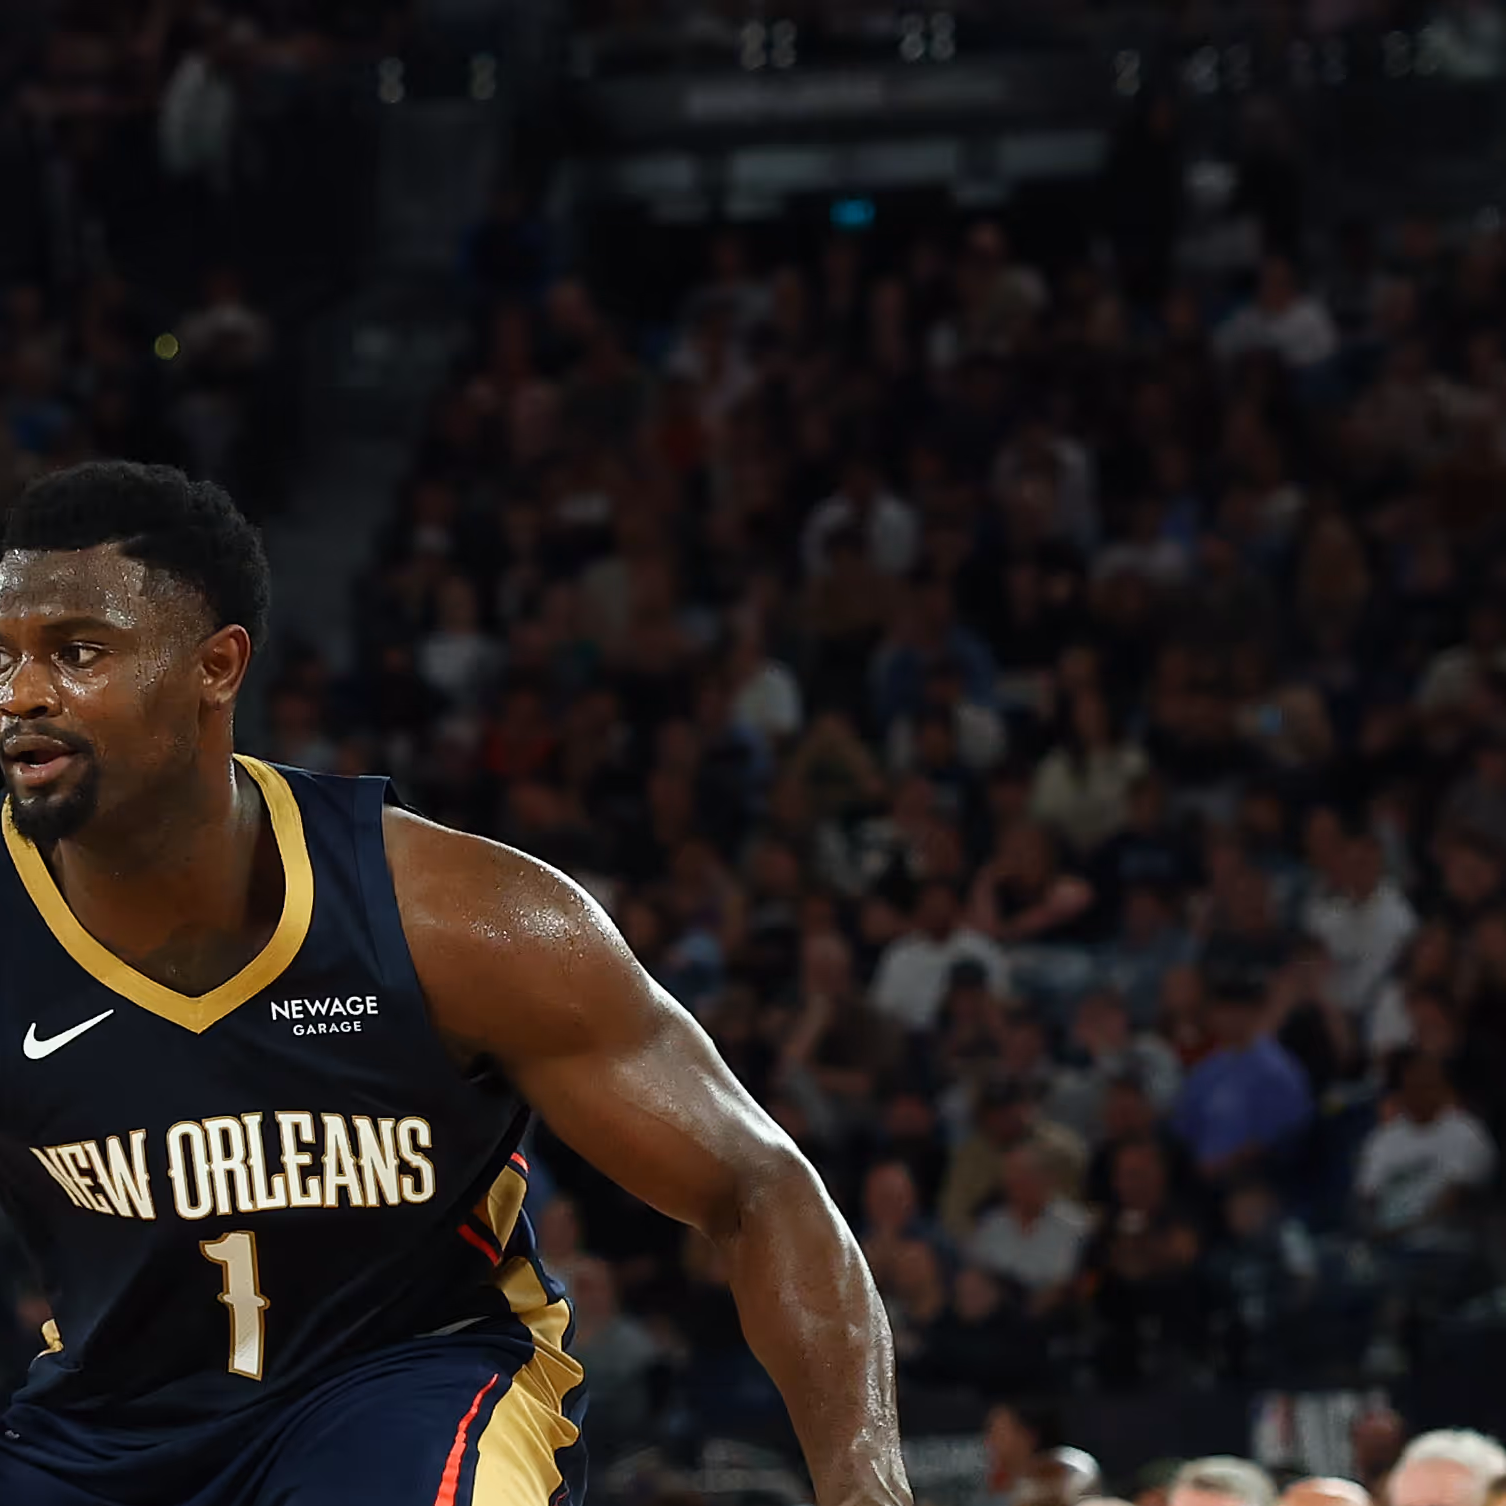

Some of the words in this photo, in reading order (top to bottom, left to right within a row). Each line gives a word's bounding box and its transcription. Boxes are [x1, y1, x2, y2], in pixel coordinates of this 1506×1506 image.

[270, 995, 379, 1021] NEWAGE
[292, 1020, 363, 1036] GARAGE
[29, 1128, 157, 1221] NEW
[167, 1111, 437, 1221] ORLEANS
[198, 1229, 271, 1382] 1
